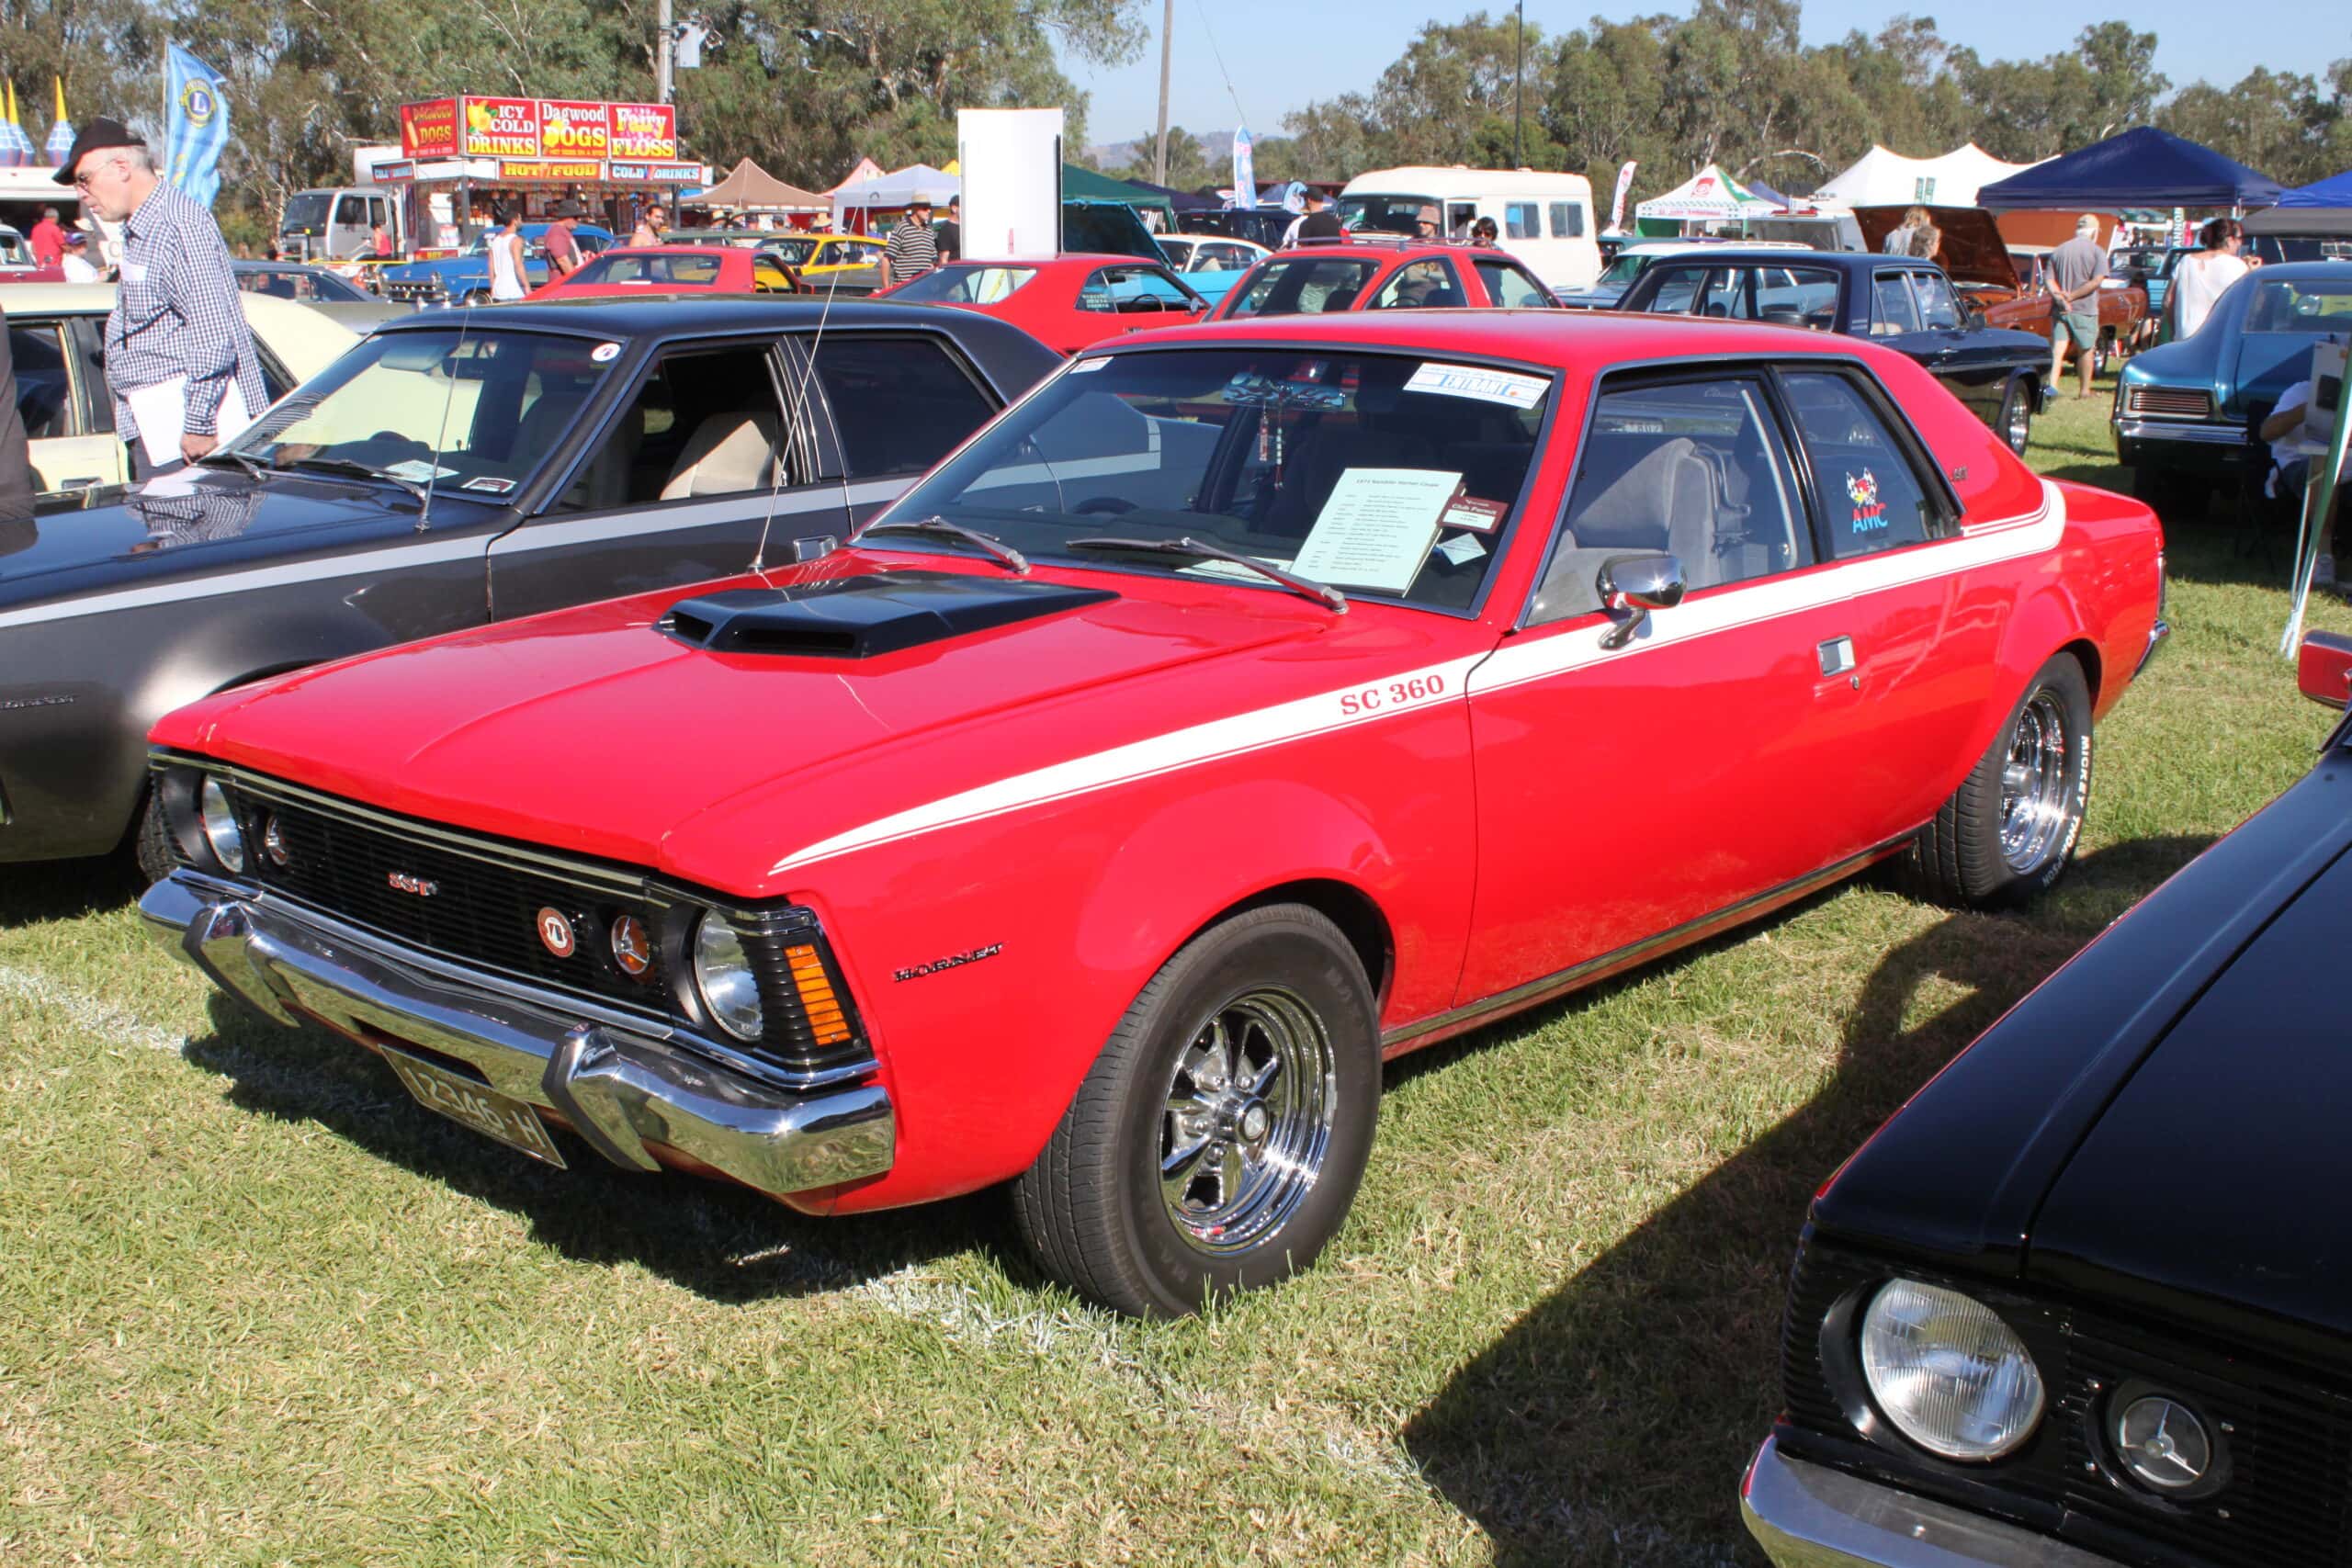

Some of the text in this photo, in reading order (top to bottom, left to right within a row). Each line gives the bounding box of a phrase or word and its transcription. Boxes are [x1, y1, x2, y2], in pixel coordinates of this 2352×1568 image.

[498, 106, 526, 118] ICY
[543, 103, 605, 126] Dagwood
[491, 119, 535, 133] COLD
[616, 107, 667, 139] Fairy
[420, 125, 452, 145] DOGS
[468, 136, 536, 155] DRINKS
[543, 125, 606, 148] DOGS
[612, 138, 674, 157] FLOSS
[503, 163, 597, 176] HOT FOOD
[612, 165, 699, 179] COLD DRINKS
[1852, 503, 1888, 534] AMC
[1340, 674, 1445, 716] SC 360
[2076, 735, 2091, 809] MICKEY
[894, 942, 1003, 984] HORNET
